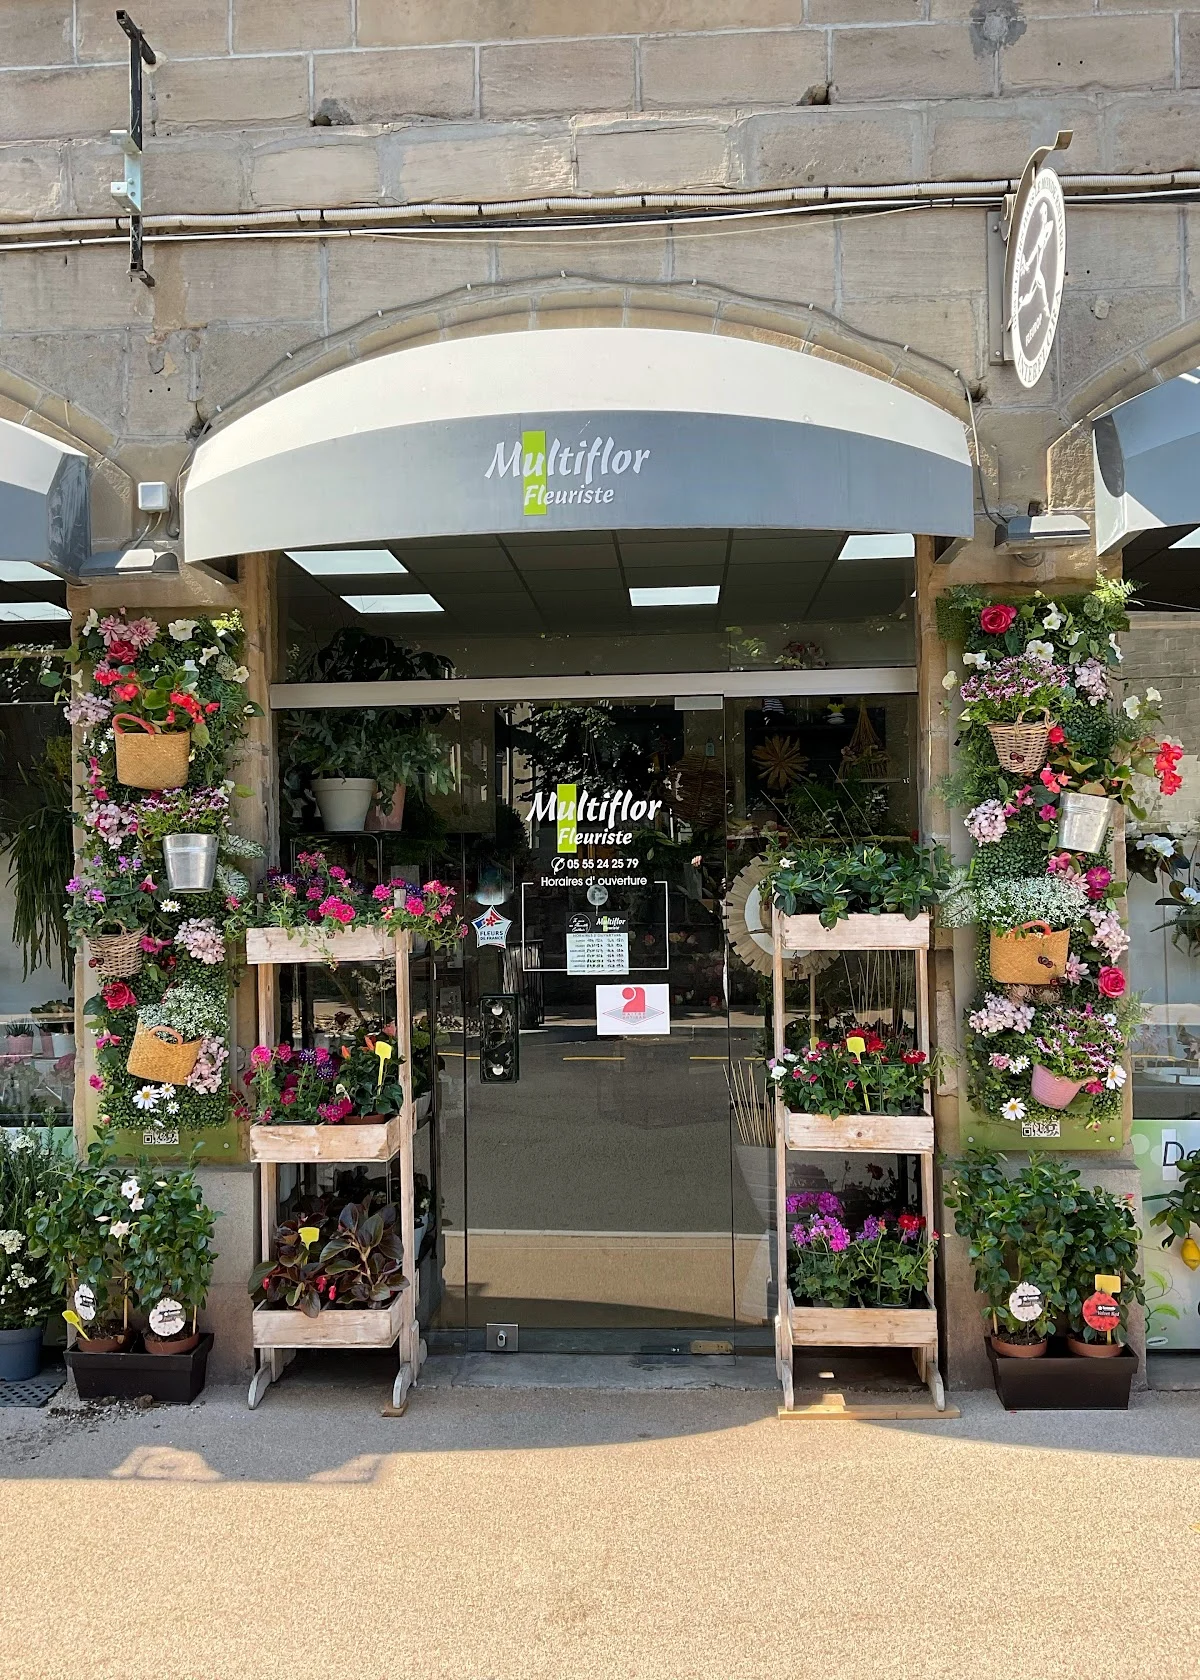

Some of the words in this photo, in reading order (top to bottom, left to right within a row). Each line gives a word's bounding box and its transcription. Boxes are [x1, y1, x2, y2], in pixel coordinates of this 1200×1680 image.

[1018, 289, 1061, 383] INTERFLORA
[484, 436, 651, 485] Multiflor
[523, 484, 614, 506] Fleuriste
[525, 789, 662, 829] Multiflor
[557, 828, 633, 845] Fleuriste
[567, 858, 579, 869] 05
[582, 858, 595, 869] 55
[597, 858, 609, 869] 24
[612, 858, 624, 869] 25
[626, 858, 639, 869] 79
[540, 876, 583, 887] Horaires
[597, 875, 648, 887] ouverture
